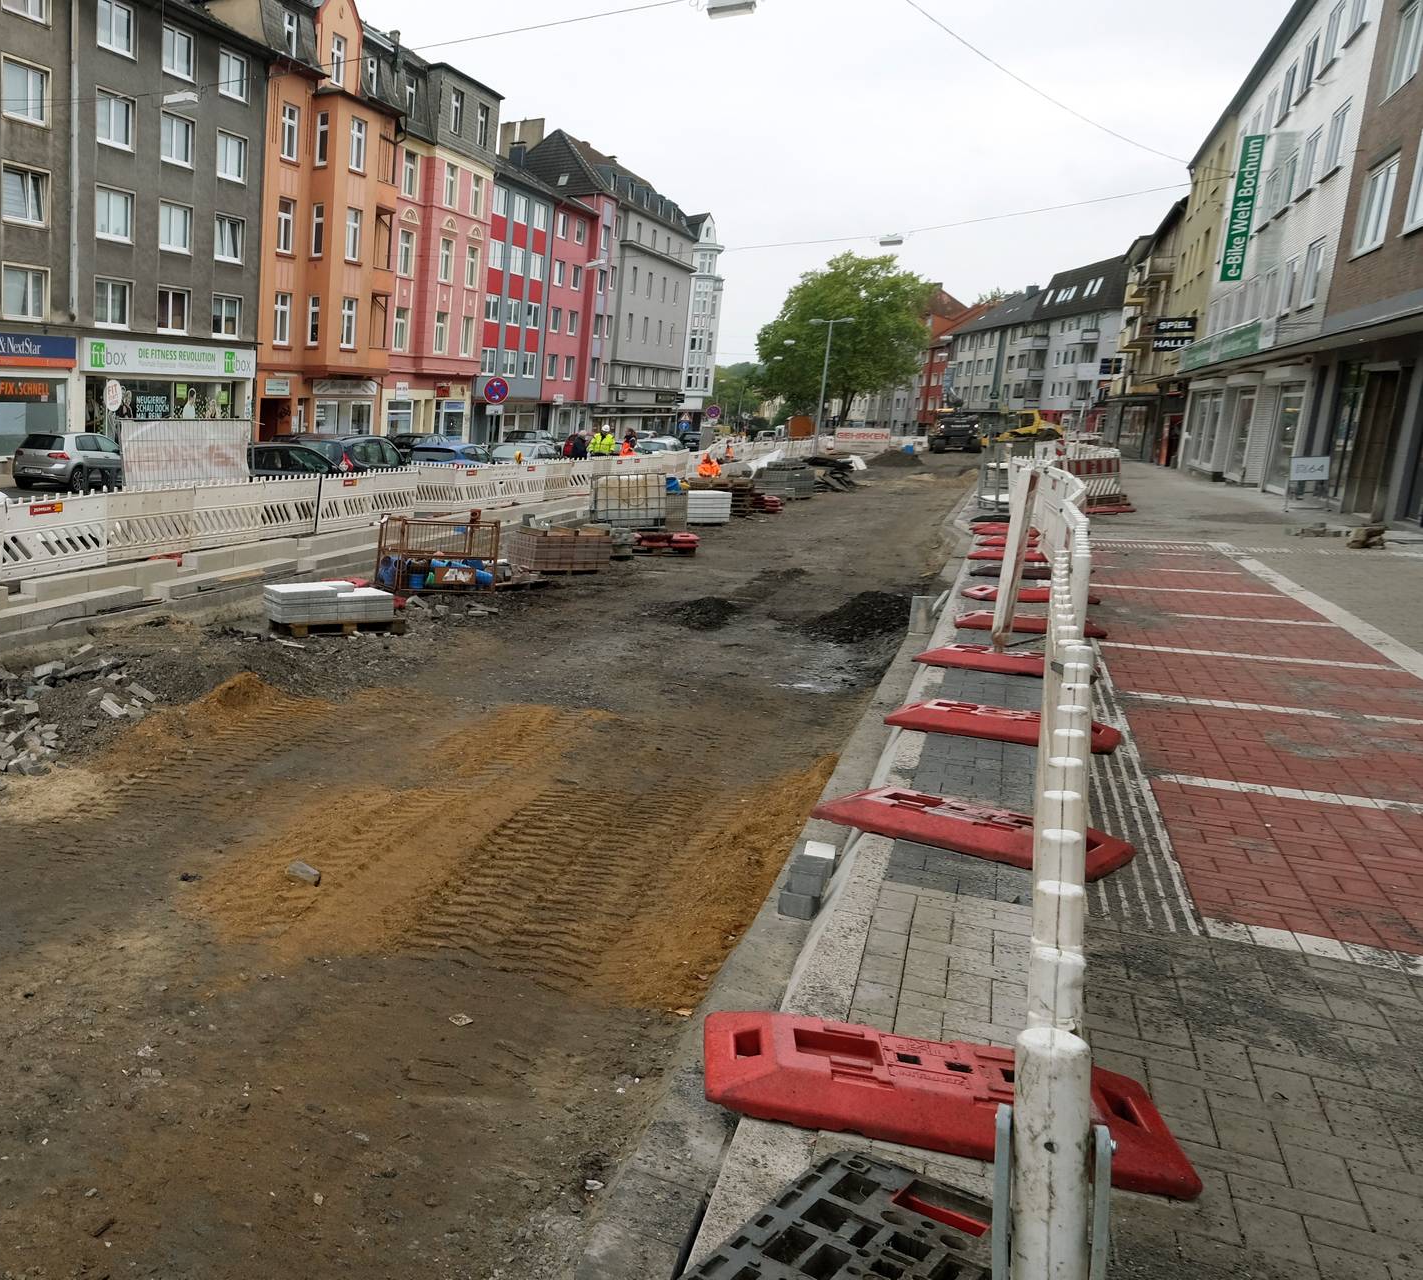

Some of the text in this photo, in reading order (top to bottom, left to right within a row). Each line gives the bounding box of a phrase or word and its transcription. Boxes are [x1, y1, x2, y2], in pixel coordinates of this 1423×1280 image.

[1225, 139, 1263, 277] e-Bike Welt Bochum
[1158, 320, 1193, 330] SPIEL
[1153, 339, 1193, 348] HALLE
[138, 348, 216, 363] DIE FITNESS REVOLUTION
[19, 382, 50, 396] SCHNELL
[136, 404, 154, 412] SCHAU
[837, 431, 889, 440] GEHRKEN
